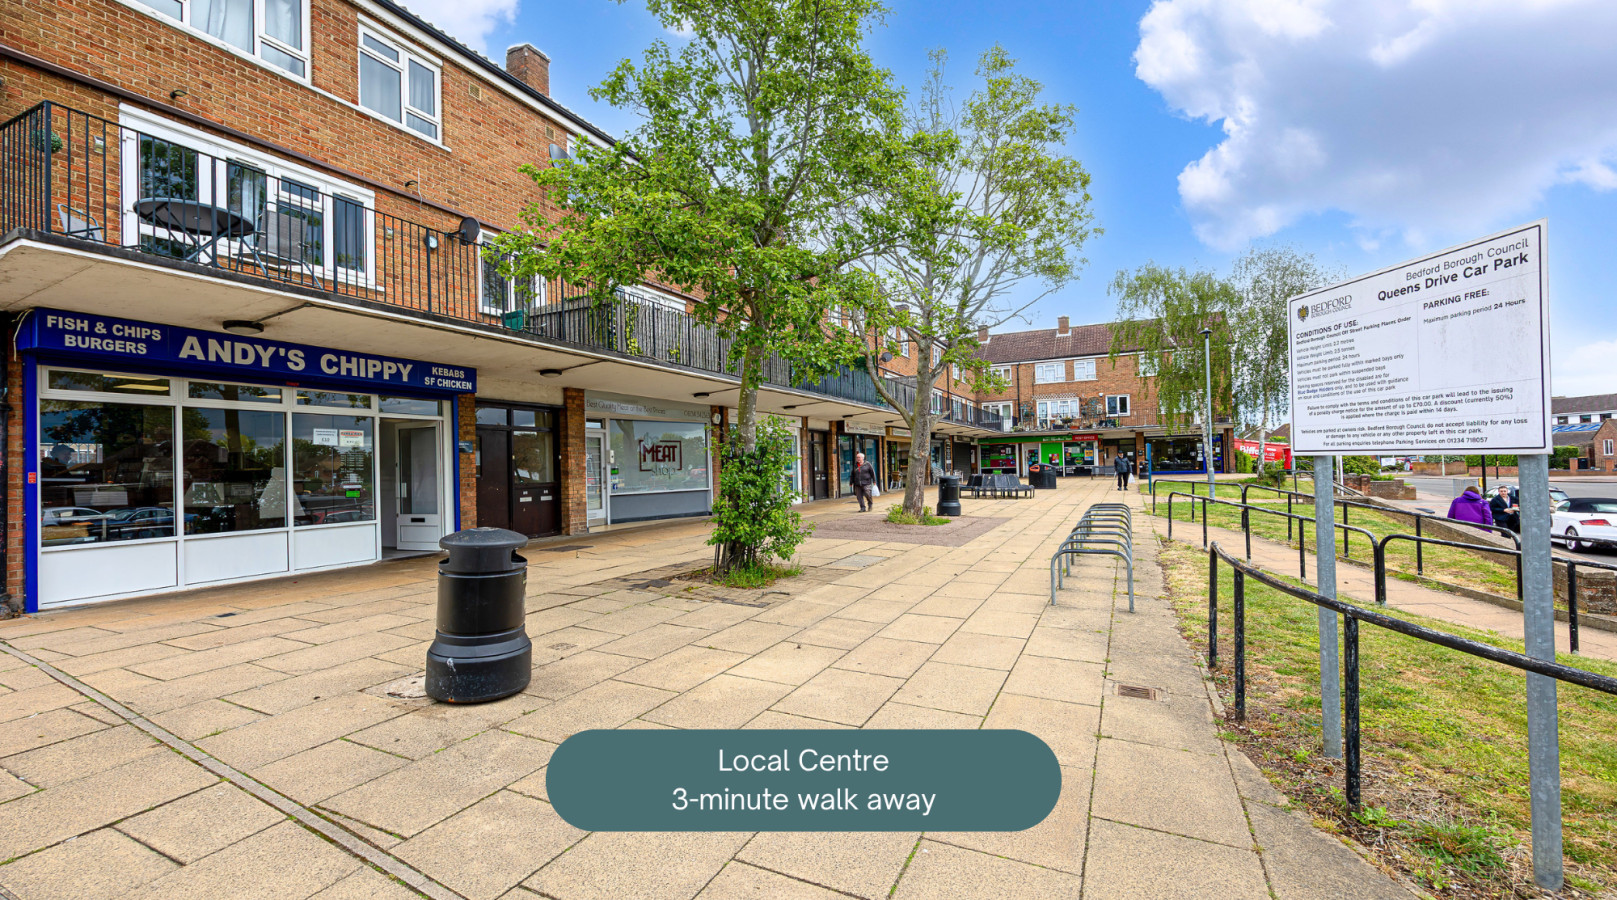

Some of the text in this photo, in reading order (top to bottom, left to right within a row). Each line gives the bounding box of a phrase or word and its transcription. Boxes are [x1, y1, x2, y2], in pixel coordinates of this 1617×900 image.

[1406, 238, 1529, 280] Bedford Borough Council
[1378, 251, 1528, 300] Queens Drive Car Park
[1311, 295, 1352, 314] BEDFORD
[1423, 289, 1490, 310] PARKING FREE:
[1423, 315, 1448, 324] Maximum
[1450, 310, 1471, 320] parking
[1473, 304, 1492, 315] period
[1505, 298, 1526, 307] Hours
[46, 315, 162, 341] FISH & CHIPS
[1296, 326, 1332, 339] CONDITIONS
[1344, 320, 1358, 329] USE:
[64, 334, 147, 354] BURGERS
[178, 336, 414, 382] ANDY'S CHIPPY
[432, 366, 464, 379] KEBABS
[424, 376, 472, 390] SF CHICKEN
[586, 400, 597, 408] Best
[598, 401, 616, 411] Quality
[643, 444, 677, 462] MEAT
[651, 462, 676, 479] shop
